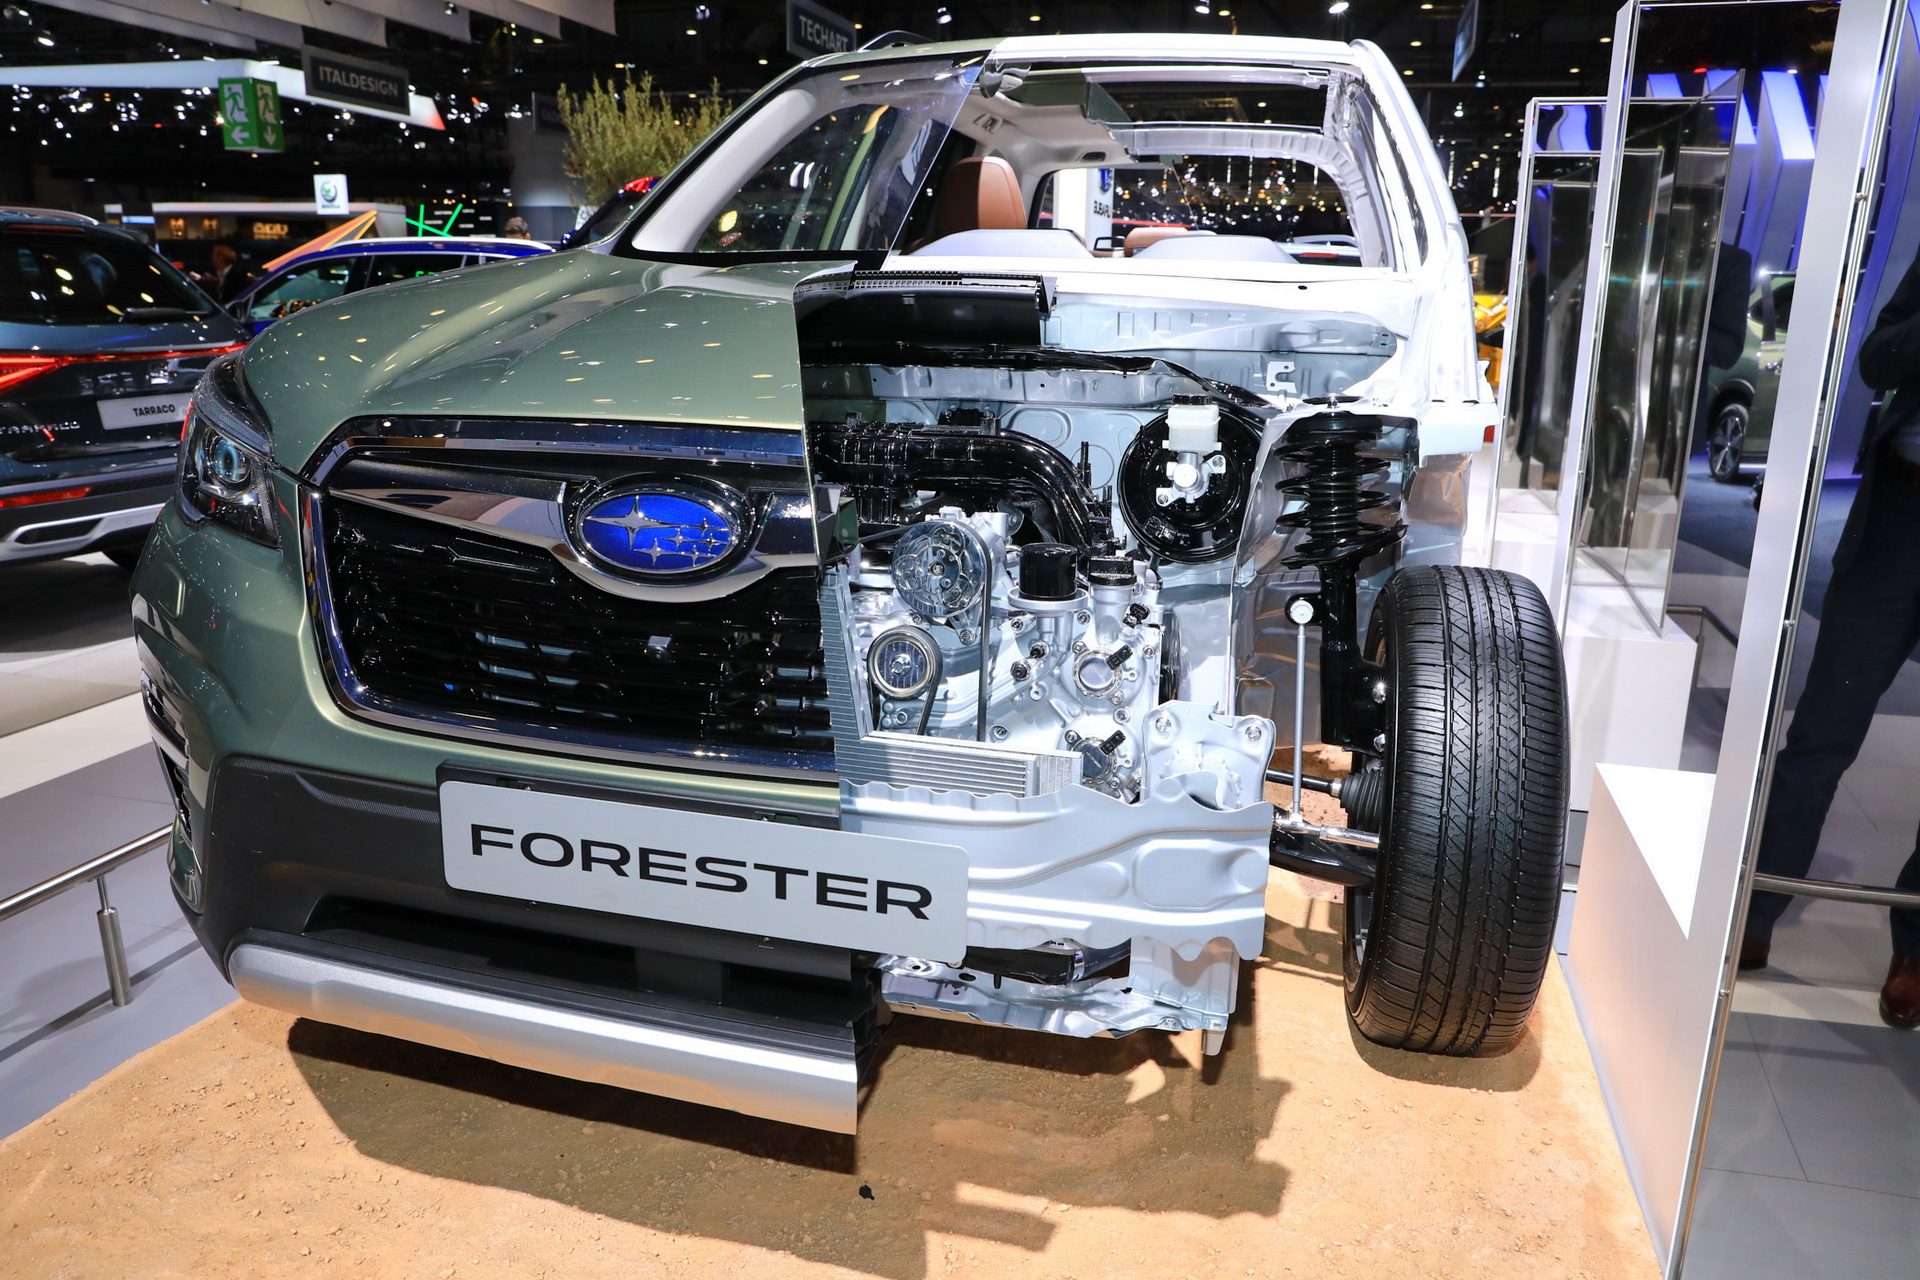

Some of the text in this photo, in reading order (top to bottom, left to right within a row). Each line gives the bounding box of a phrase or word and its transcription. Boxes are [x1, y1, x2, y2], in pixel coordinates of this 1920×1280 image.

[799, 14, 848, 52] TECHART
[319, 65, 398, 97] ITALDESIGN
[132, 404, 175, 417] TARRACO
[471, 823, 932, 920] FORESTER
